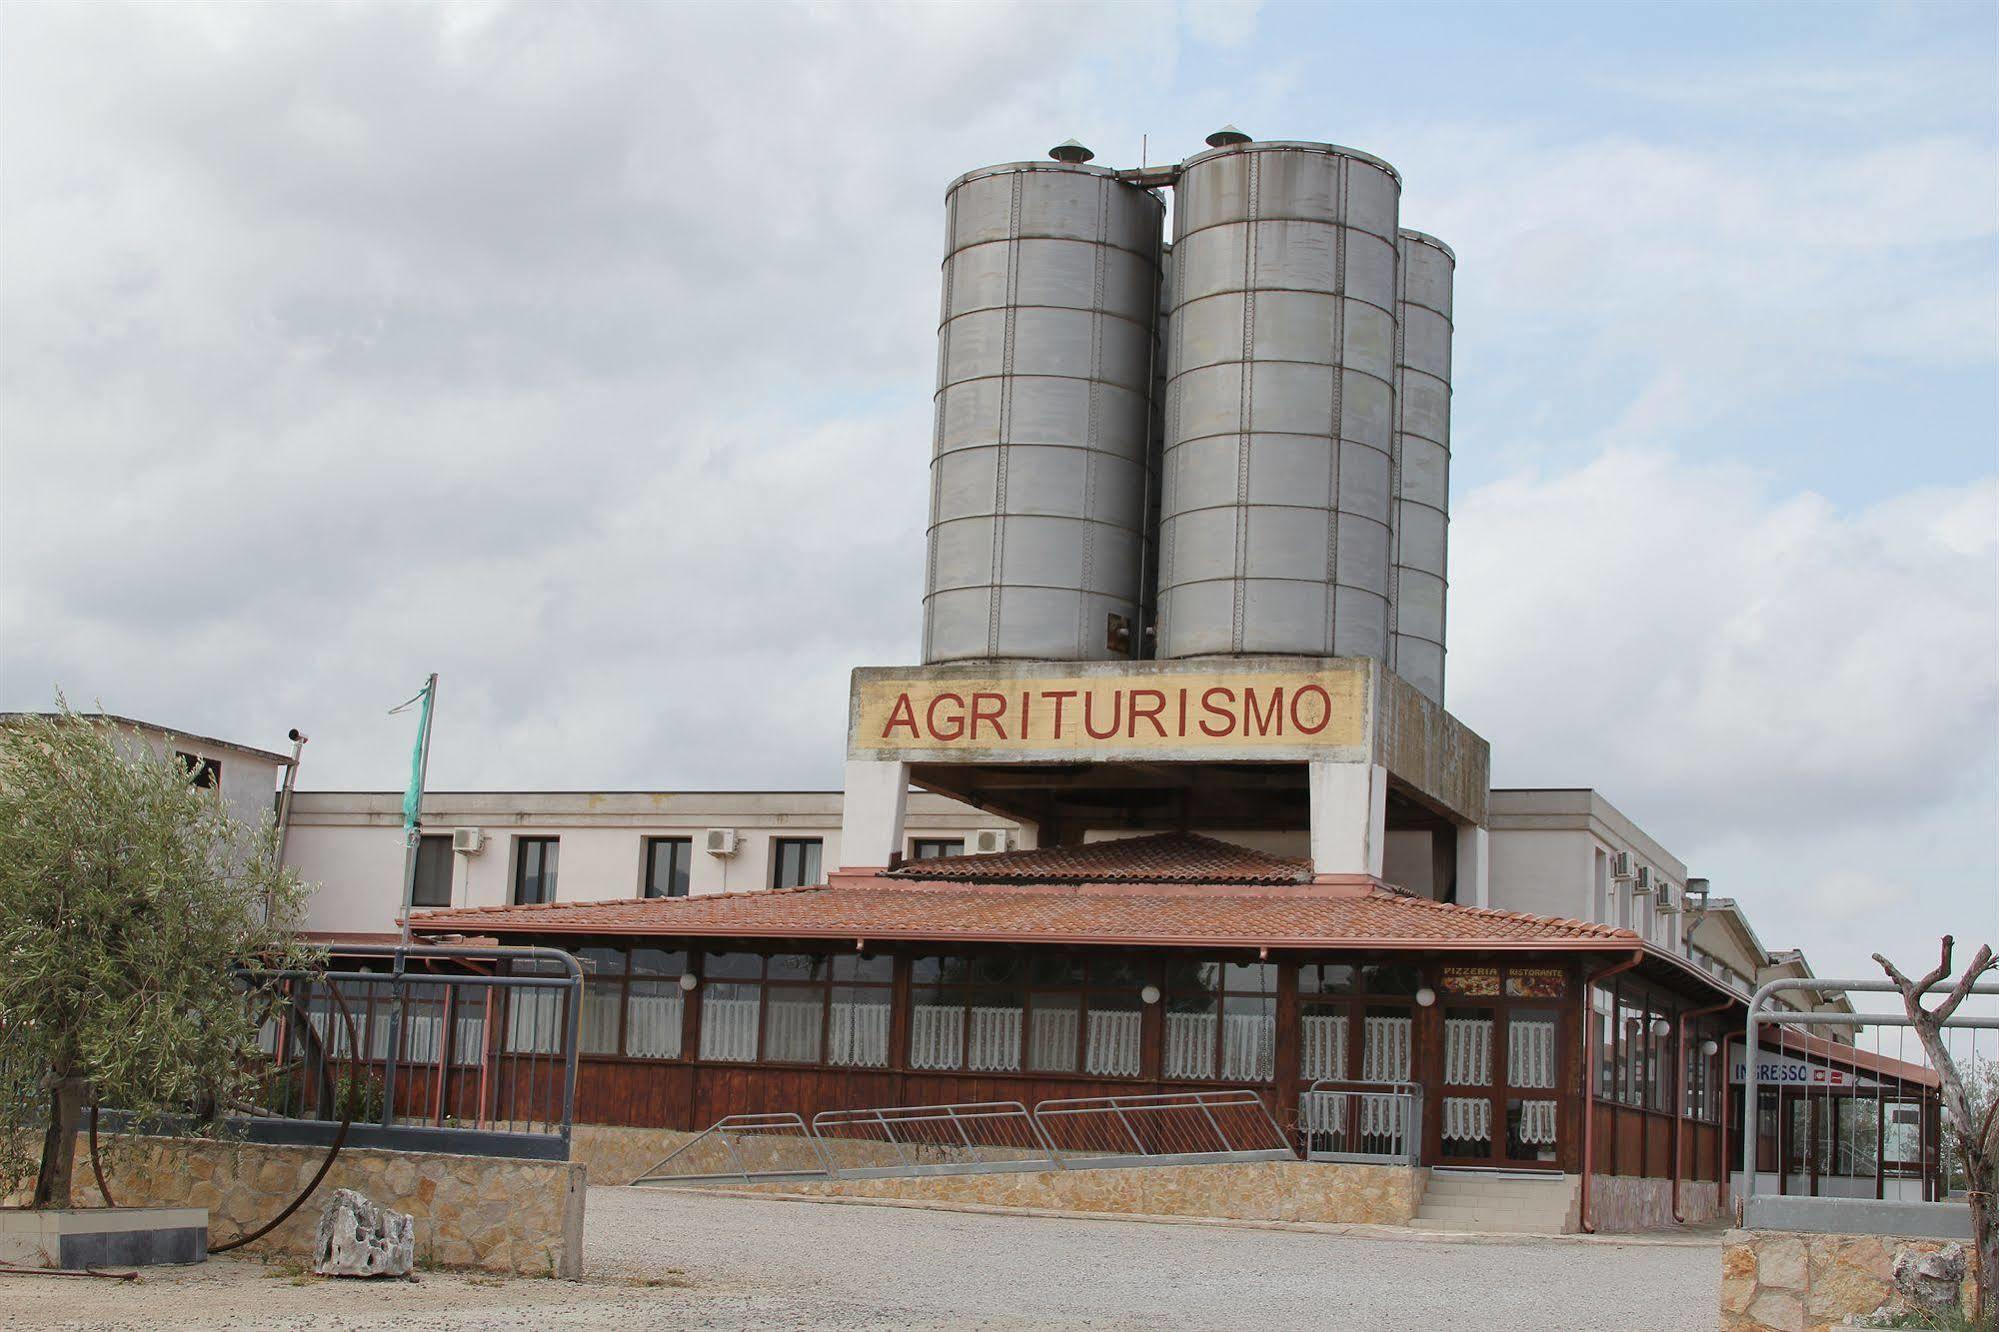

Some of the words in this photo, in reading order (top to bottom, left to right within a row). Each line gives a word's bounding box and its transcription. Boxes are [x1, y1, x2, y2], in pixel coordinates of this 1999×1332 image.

[881, 684, 1332, 741] AGRITURISMO
[1443, 967, 1498, 975] PIZZERIA
[1509, 968, 1564, 977] RISTORANTE
